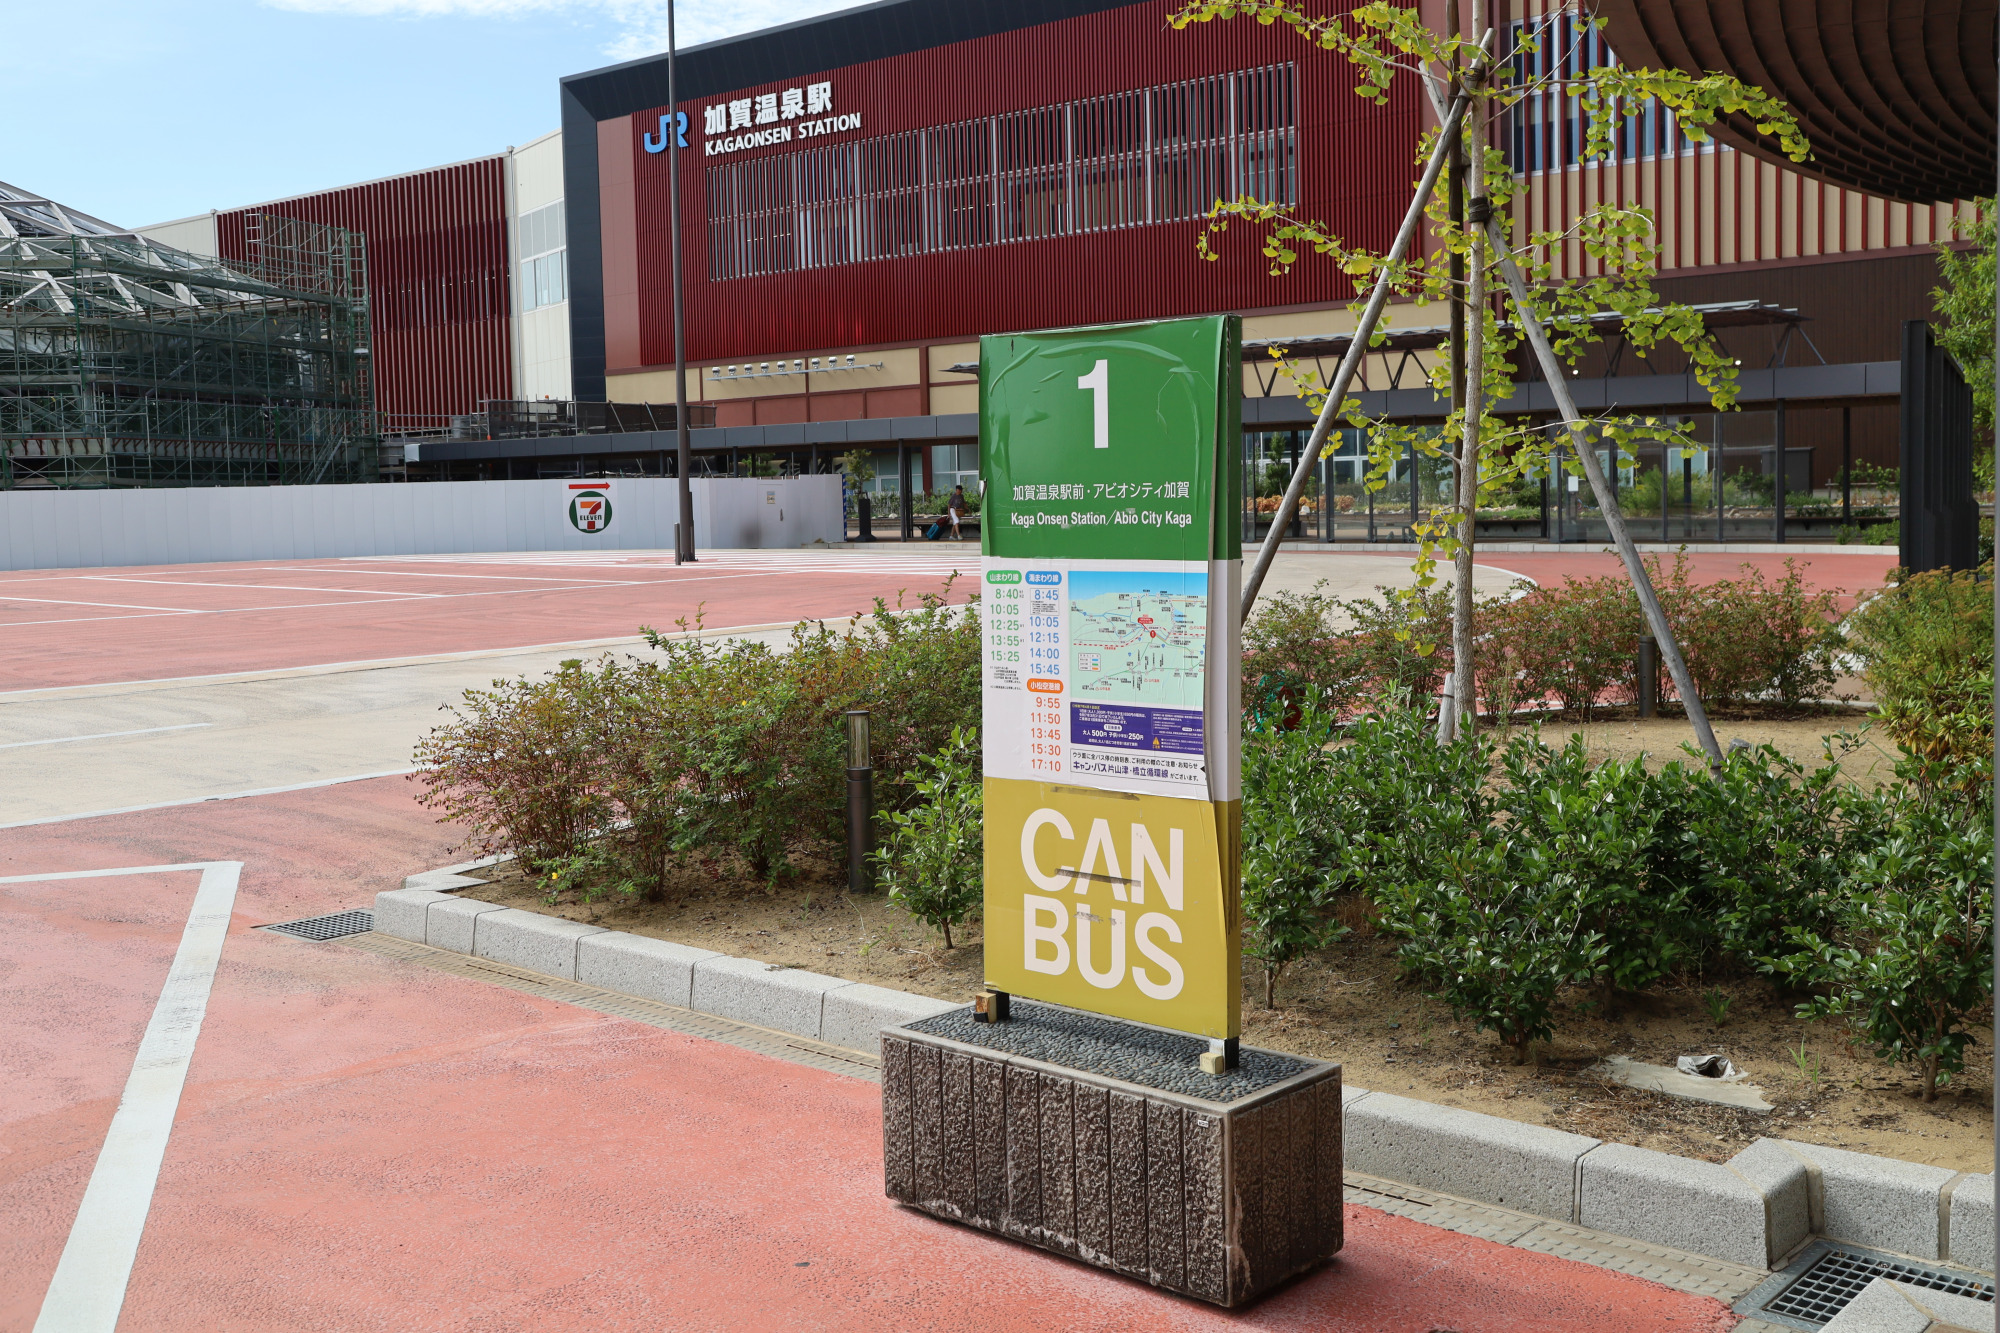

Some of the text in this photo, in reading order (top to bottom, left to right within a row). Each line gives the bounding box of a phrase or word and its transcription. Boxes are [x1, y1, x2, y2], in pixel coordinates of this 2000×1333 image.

[704, 81, 833, 136] 加賀温泉駅
[644, 112, 689, 154] JR
[705, 112, 862, 157] KAGAONSEN STATION
[1078, 359, 1109, 449] 1
[1013, 481, 1190, 501] 加賀温泉駅前・アビオシティ加賀
[580, 501, 602, 530] 7
[1011, 512, 1035, 528] Kaga
[1037, 511, 1069, 526] Onsen
[1141, 511, 1163, 528] City
[1165, 511, 1192, 528] Kaga
[995, 588, 1019, 600] 8:40
[1034, 589, 1059, 601] 8:45
[990, 603, 1019, 615] 10:05
[990, 619, 1019, 631] 12:25
[1030, 616, 1059, 628] 10:05
[991, 635, 1020, 647] 13:55
[1030, 632, 1059, 644] 12:15
[991, 650, 1020, 662] 15:25
[1030, 647, 1060, 659] 14:00
[1030, 663, 1060, 675] 15:45
[1036, 696, 1060, 709] 9:55
[1031, 712, 1061, 725] 11:50
[1031, 728, 1061, 740] 13:45
[1031, 743, 1061, 756] 15:30
[1031, 758, 1061, 772] 17:10
[1020, 807, 1184, 911] CAN
[1024, 893, 1185, 1001] BUS
